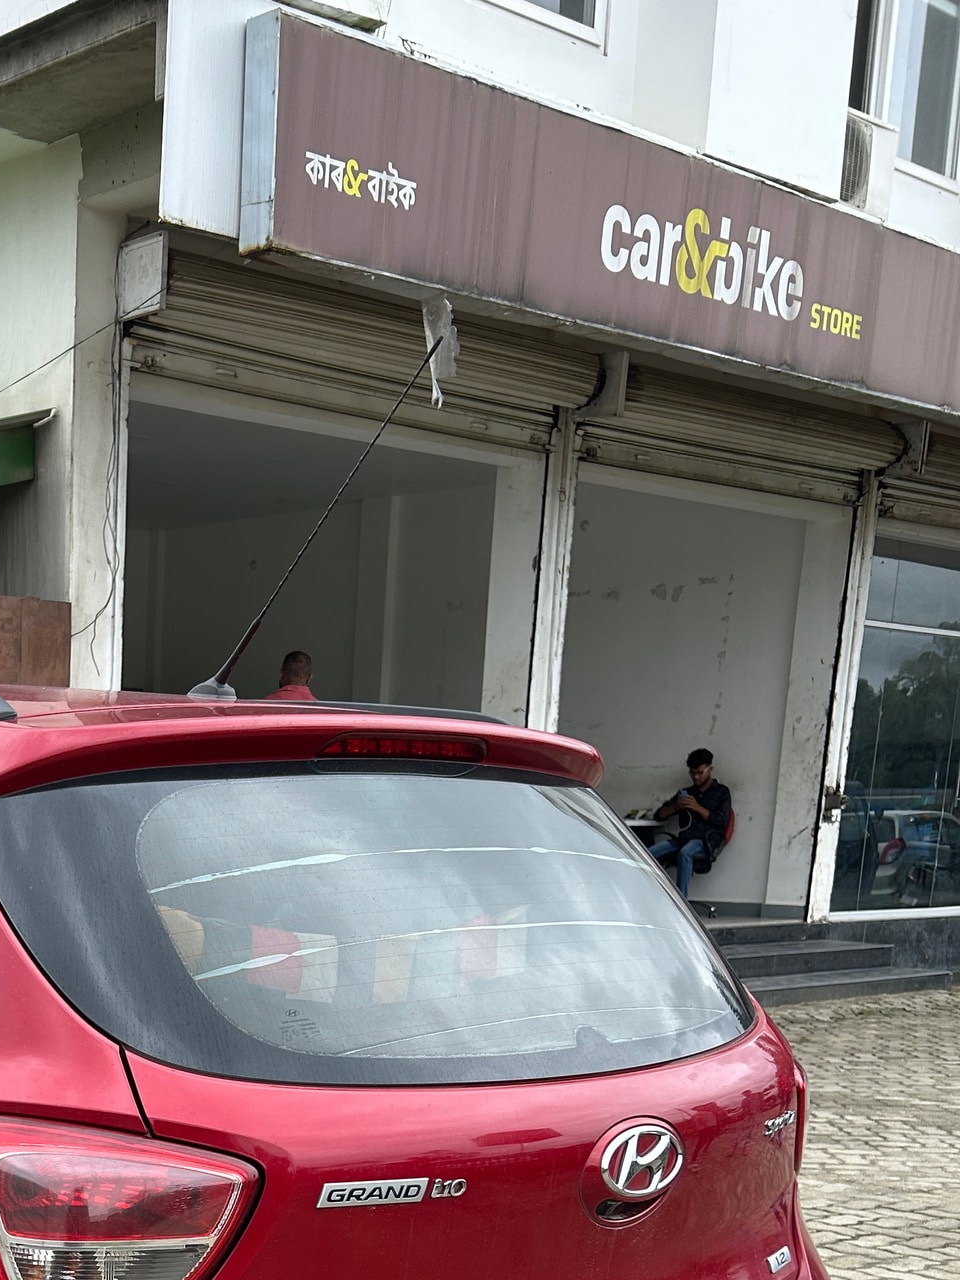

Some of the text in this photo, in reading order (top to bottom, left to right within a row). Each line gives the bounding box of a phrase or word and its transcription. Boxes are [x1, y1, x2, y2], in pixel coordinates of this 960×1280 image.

[600, 203, 863, 340] car&bike STORE
[326, 1184, 422, 1203] GRAND
